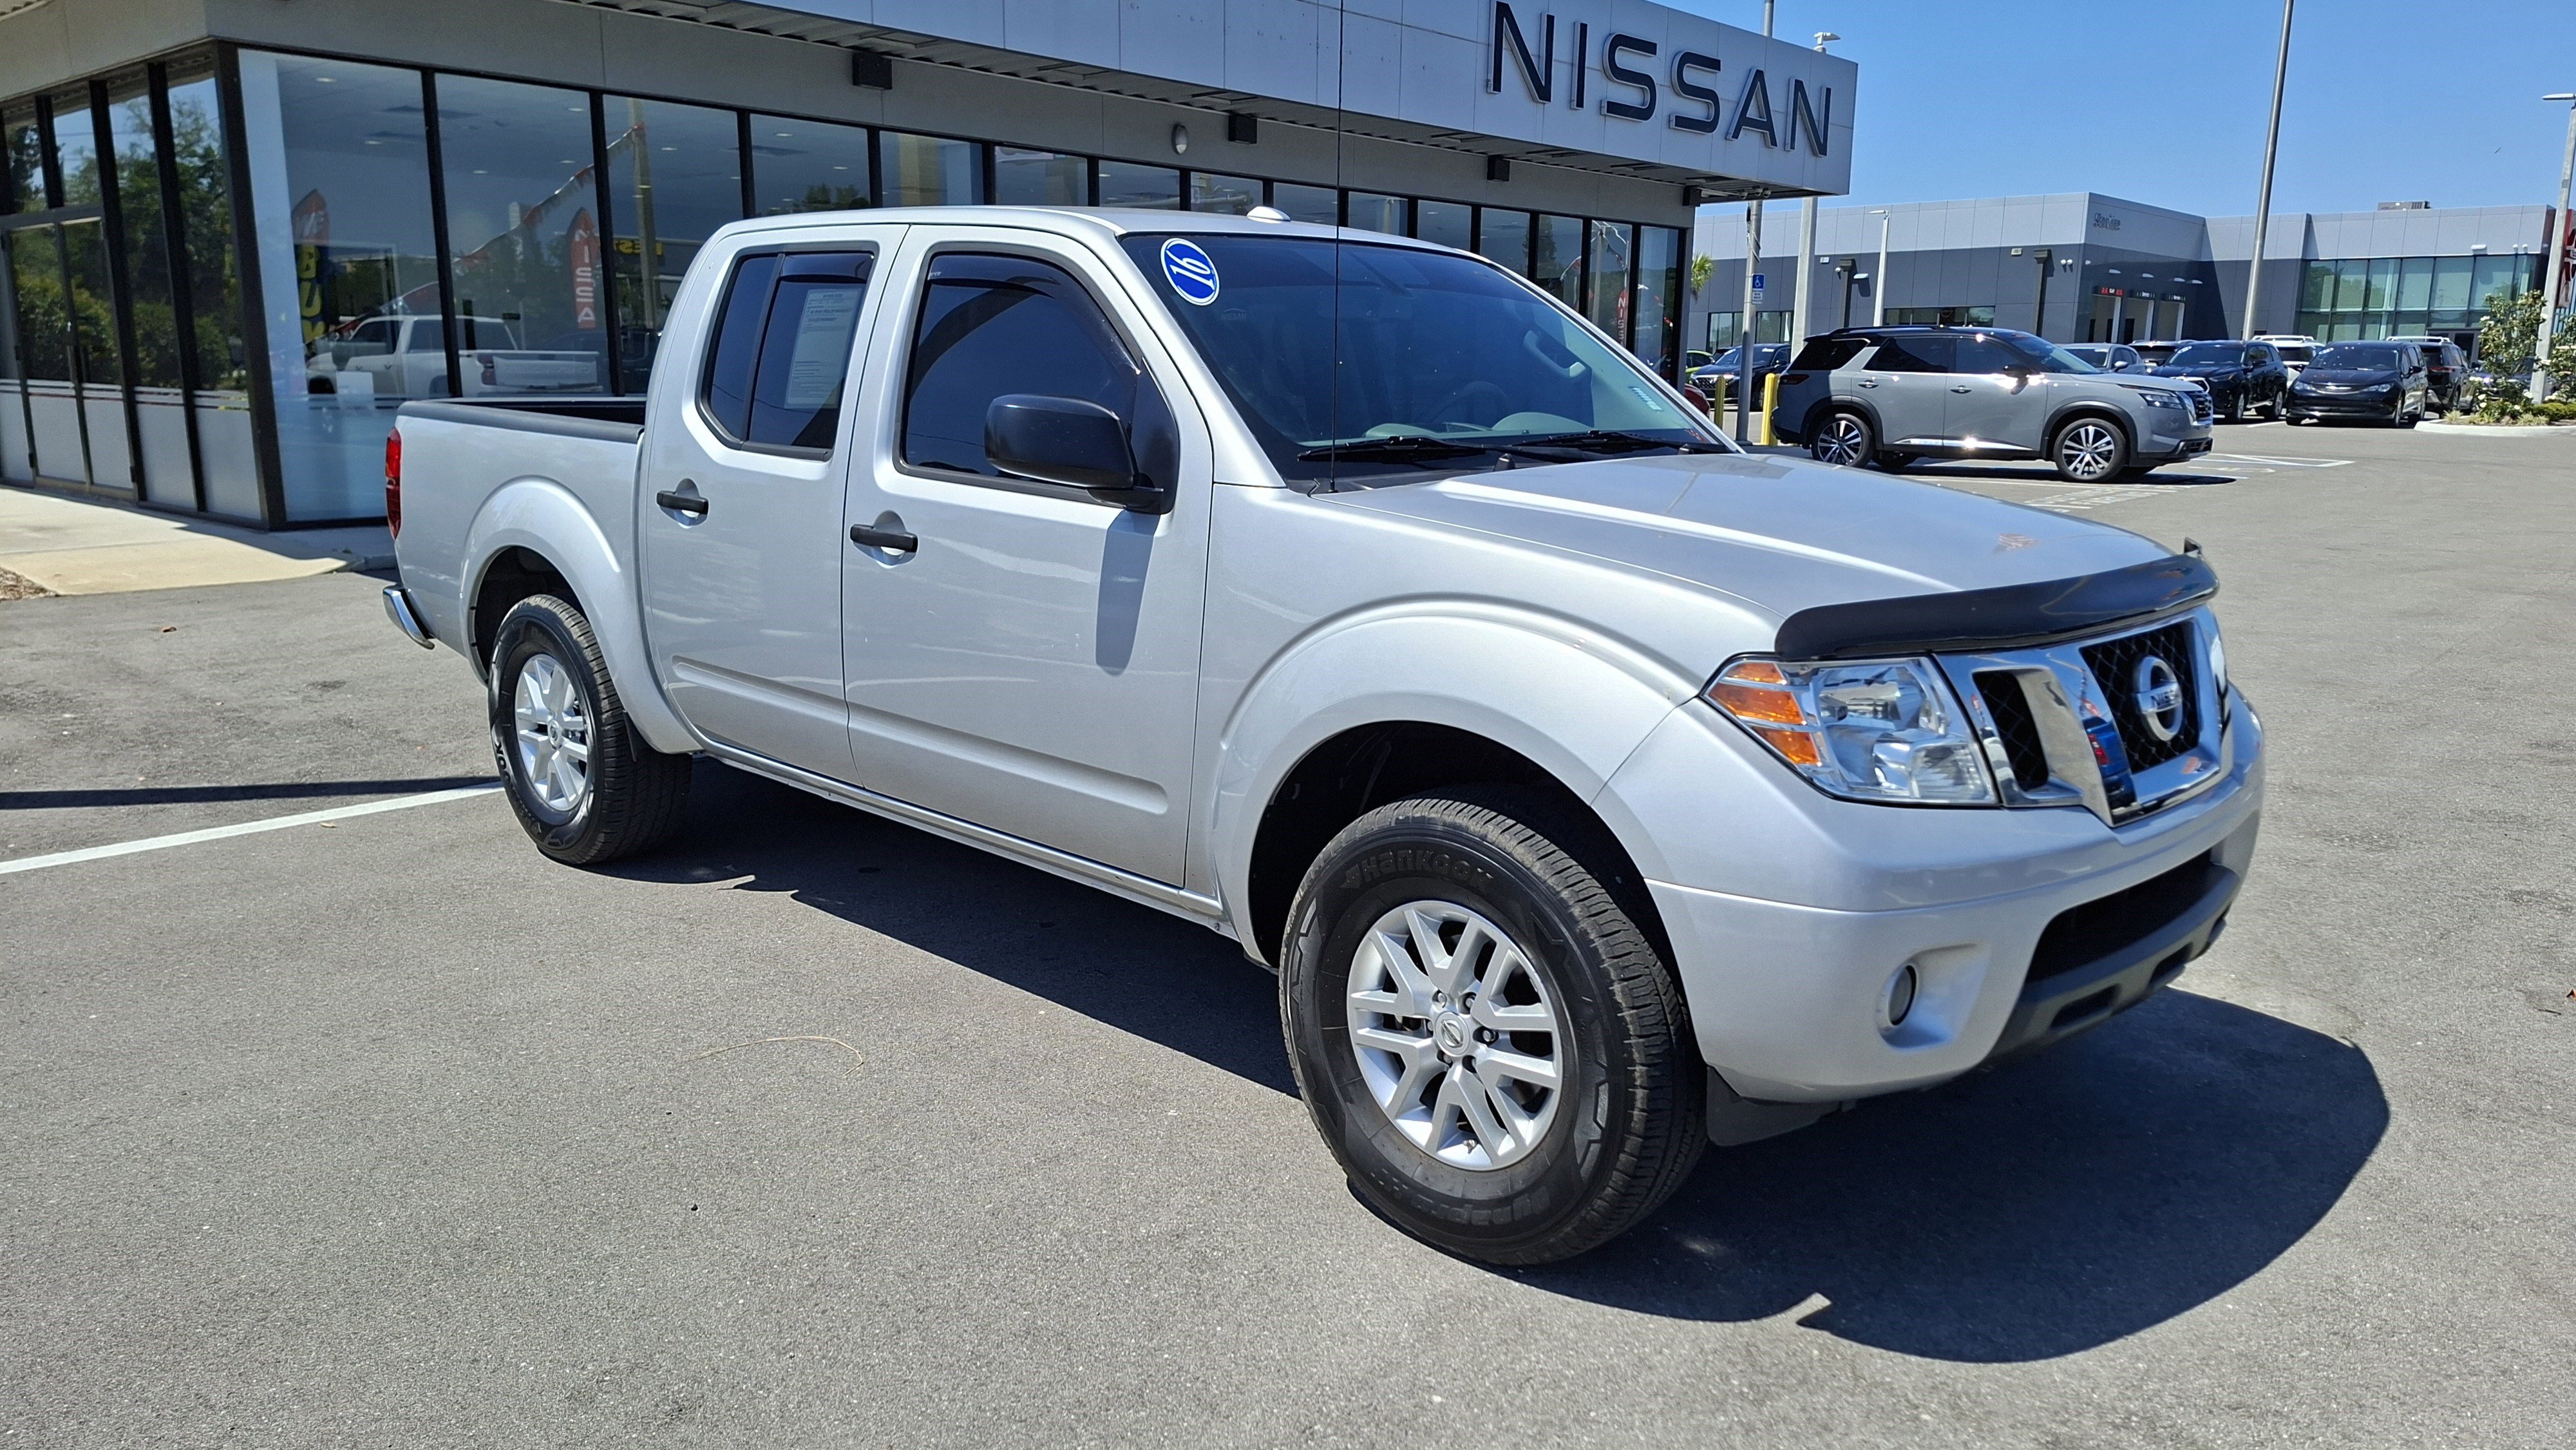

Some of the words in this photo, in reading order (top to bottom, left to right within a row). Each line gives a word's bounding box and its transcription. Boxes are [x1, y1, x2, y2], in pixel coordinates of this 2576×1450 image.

[1487, 1, 1832, 157] NISSAN
[2094, 212, 2121, 231] Service
[1166, 249, 1215, 290] 16
[1617, 297, 1626, 344] NISS
